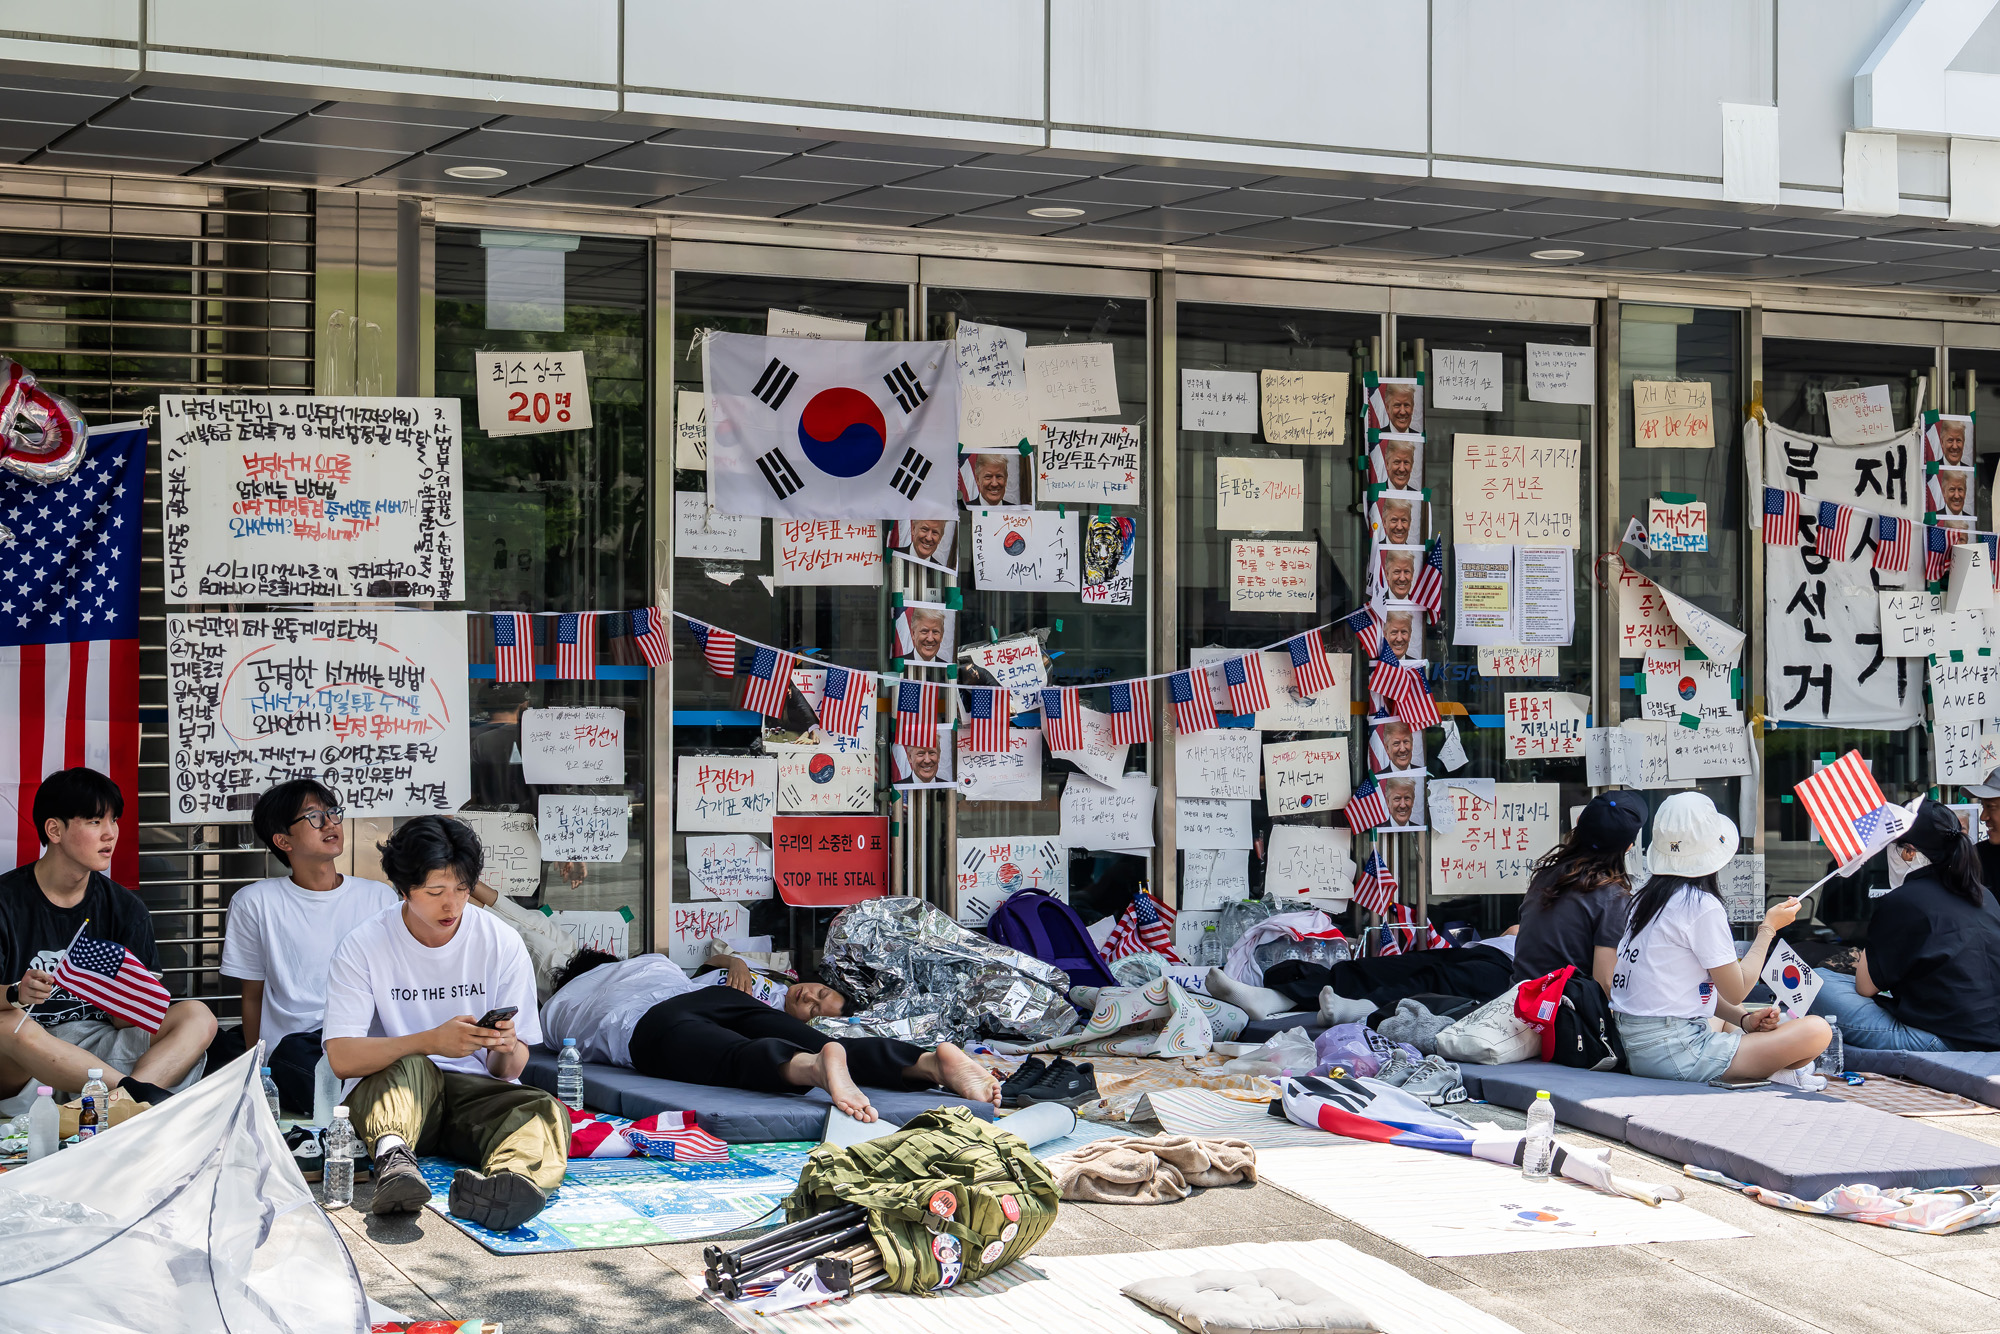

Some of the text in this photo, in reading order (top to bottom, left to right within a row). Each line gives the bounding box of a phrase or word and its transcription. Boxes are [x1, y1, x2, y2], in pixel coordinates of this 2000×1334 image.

[492, 357, 566, 388] 최소 상주
[1038, 357, 1079, 378] 잠실에서
[1442, 355, 1479, 375] 재선거
[1046, 382, 1079, 399] 민주화
[1080, 378, 1097, 394] 운동
[1639, 385, 1698, 405] 재선거
[507, 391, 572, 424] 20명
[1044, 425, 1098, 450] 부정선거
[1099, 431, 1139, 450] 재선거
[1042, 449, 1139, 471] 당일투표 수개표
[1464, 444, 1578, 470] 투표용지 지키자!
[242, 451, 352, 485] 부정선거 음모론
[235, 478, 338, 500] 없애는 방법
[1219, 474, 1261, 508] 투표함을
[1480, 475, 1544, 501] 증거보존
[780, 519, 878, 543] 당일투표 수개표
[1462, 510, 1572, 539] 부정선거 진상규명
[1651, 506, 1706, 537] 재선거
[781, 547, 884, 572] 부정선거 재선거
[1235, 544, 1265, 558] 증거물
[1236, 559, 1258, 573] 건물
[1237, 574, 1267, 587] 투표함
[1082, 584, 1108, 602] 자유
[1110, 591, 1131, 604] 민국
[1236, 588, 1264, 601] Stop
[1265, 588, 1283, 598] the
[1888, 595, 1943, 620] 선관위
[187, 616, 270, 638] 선관위 조사
[1623, 623, 1679, 649] 부정선거
[1902, 625, 1936, 648] 대빵
[184, 642, 227, 661] 진짜
[983, 643, 1038, 667] 표 건들지마!
[170, 660, 224, 684] 대통령
[247, 655, 426, 695] 공정한 선거하는 방법
[996, 662, 1038, 682] 손 모가지
[1492, 652, 1541, 677] 부정선거
[1647, 656, 1733, 684] 부정선거 재선거
[173, 680, 220, 707] 윤석열
[317, 689, 375, 717] 당일투표
[1942, 691, 1987, 709] AWEB
[178, 704, 214, 722] 석방
[1507, 696, 1553, 721] 투표용지
[1646, 701, 1733, 719] 당일투표 수개표
[178, 721, 216, 750] 복귀
[573, 723, 619, 749] 부정선거
[1521, 717, 1580, 739] 지킵시다!
[259, 746, 316, 767] 재선거
[962, 753, 997, 769] 당일투표
[340, 765, 413, 786] 국민유투버
[695, 767, 755, 795] 부정선거
[1200, 767, 1229, 783] 수개표
[1277, 769, 1324, 787] 재선거
[197, 793, 226, 812] 국민
[694, 790, 775, 819] 수개표 재선거
[1070, 796, 1094, 812] 자유는
[1501, 801, 1550, 822] 지킵시다
[557, 814, 609, 835] 부정선거
[1071, 814, 1087, 825] 자유
[778, 833, 883, 853] 우리의 소중한 0 표
[1461, 826, 1530, 852] 증거보존
[987, 843, 1037, 864] 부정선거
[1203, 852, 1213, 861] 06
[1217, 851, 1226, 861] 07
[783, 871, 811, 888] STOP
[818, 871, 838, 887] THE
[844, 871, 876, 887] STEAL
[957, 867, 1065, 891] 당일투표 수개표
[1440, 857, 1488, 884] 부정선거
[1216, 877, 1246, 891] 대한민국
[1181, 920, 1198, 931] 자유
[391, 982, 486, 1001] STOP THE STEAL
[931, 1199, 949, 1216] CCP
[938, 1193, 955, 1209] OUT
